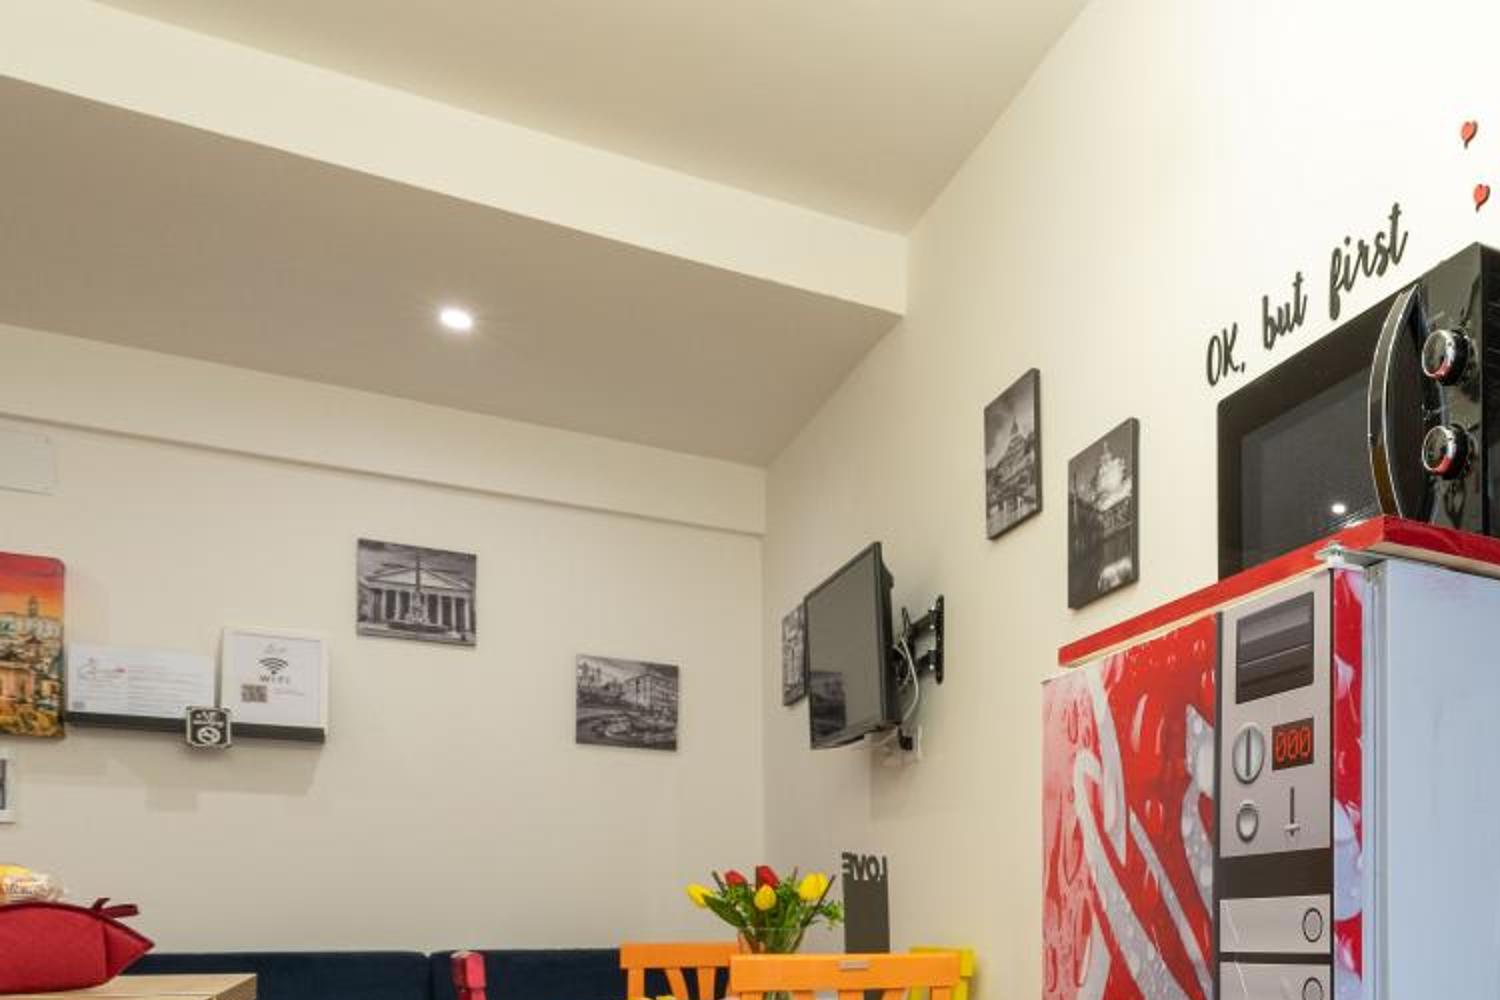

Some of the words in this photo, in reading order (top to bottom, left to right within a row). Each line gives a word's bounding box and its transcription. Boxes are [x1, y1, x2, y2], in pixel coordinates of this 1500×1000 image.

[1206, 322, 1246, 387] OK,
[1263, 271, 1308, 350] but
[1328, 201, 1409, 321] first
